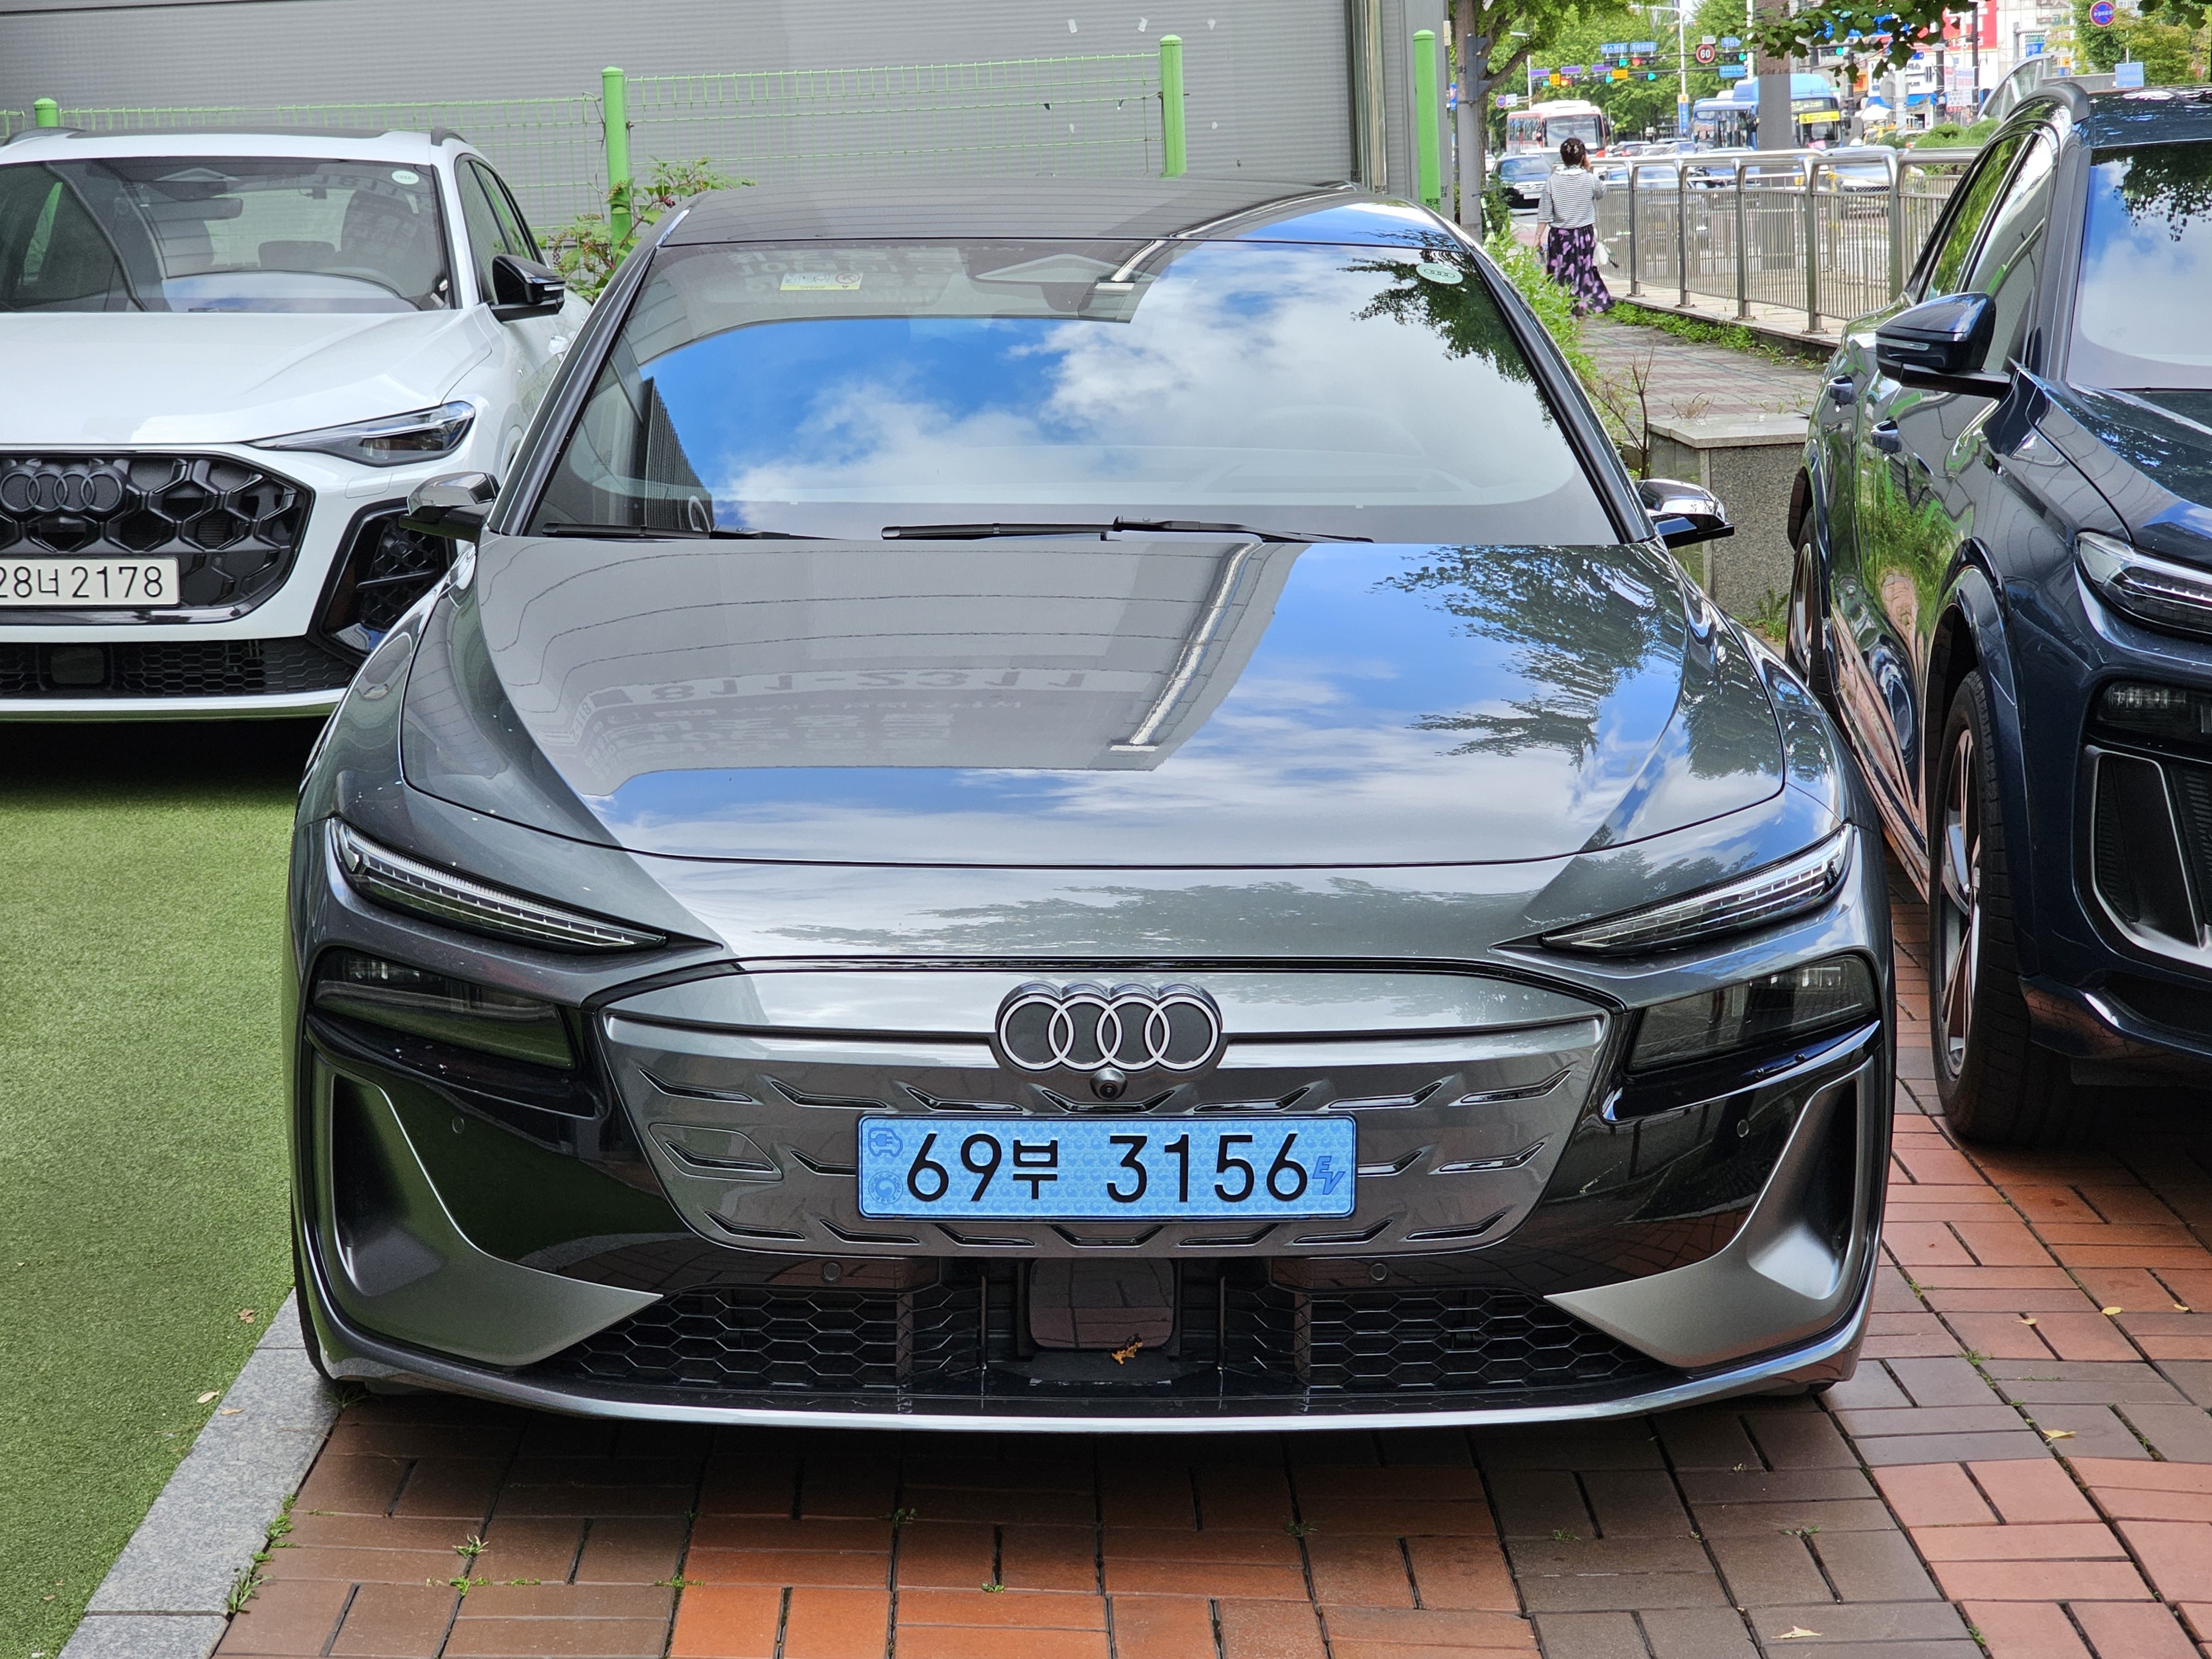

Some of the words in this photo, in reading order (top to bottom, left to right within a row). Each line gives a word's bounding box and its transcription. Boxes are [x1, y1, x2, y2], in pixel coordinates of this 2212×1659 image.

[1700, 49, 1711, 59] 60
[71, 565, 163, 598] 2178
[907, 1133, 1058, 1201] 69부
[1107, 1133, 1308, 1203] 3156
[1312, 1156, 1345, 1195] EV
